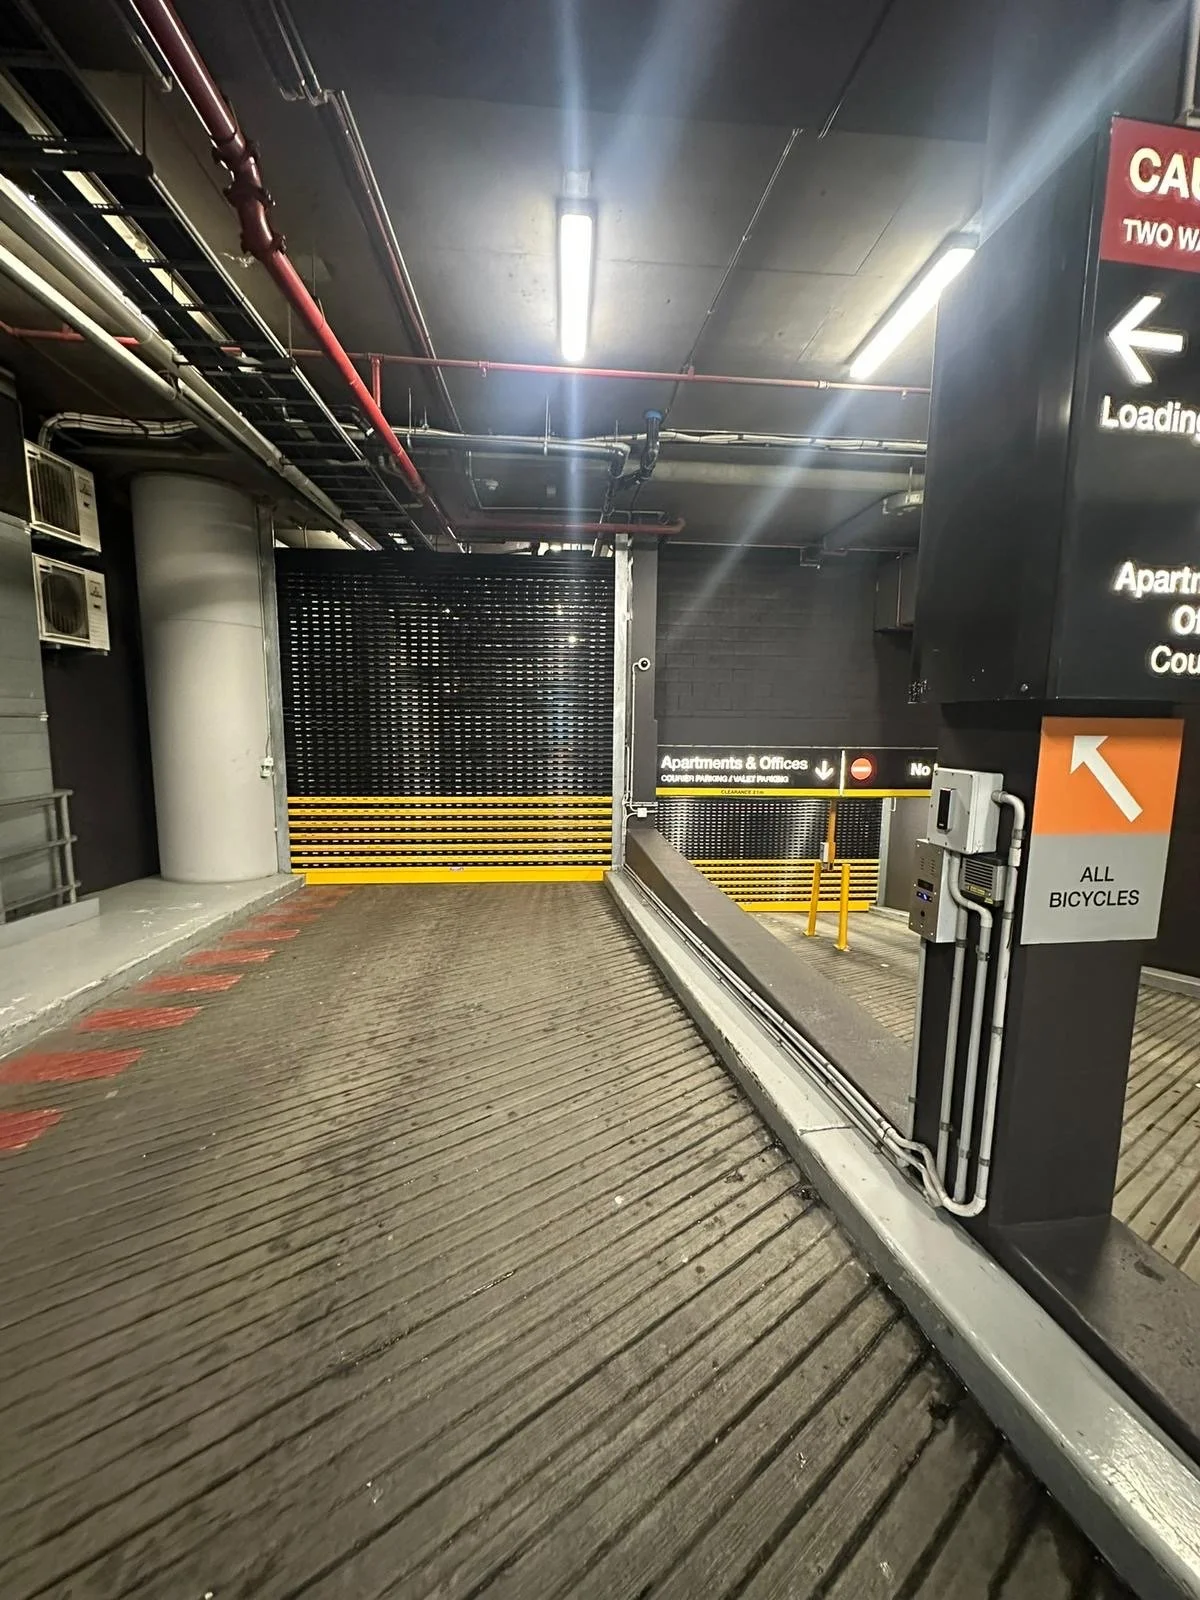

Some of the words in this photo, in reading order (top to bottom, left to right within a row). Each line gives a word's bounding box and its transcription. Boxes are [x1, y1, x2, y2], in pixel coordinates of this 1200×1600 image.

[1123, 218, 1173, 248] TWO
[1178, 225, 1200, 252] W
[1101, 396, 1200, 444] Loadin
[661, 755, 743, 771] Apartments
[746, 756, 757, 770] &
[760, 756, 808, 770] Offices
[910, 762, 931, 776] No
[695, 774, 727, 783] PARKING
[734, 775, 756, 783] VALET
[756, 775, 789, 783] PARKING
[1080, 866, 1114, 882] ALL
[1049, 889, 1140, 908] BICYCLES
